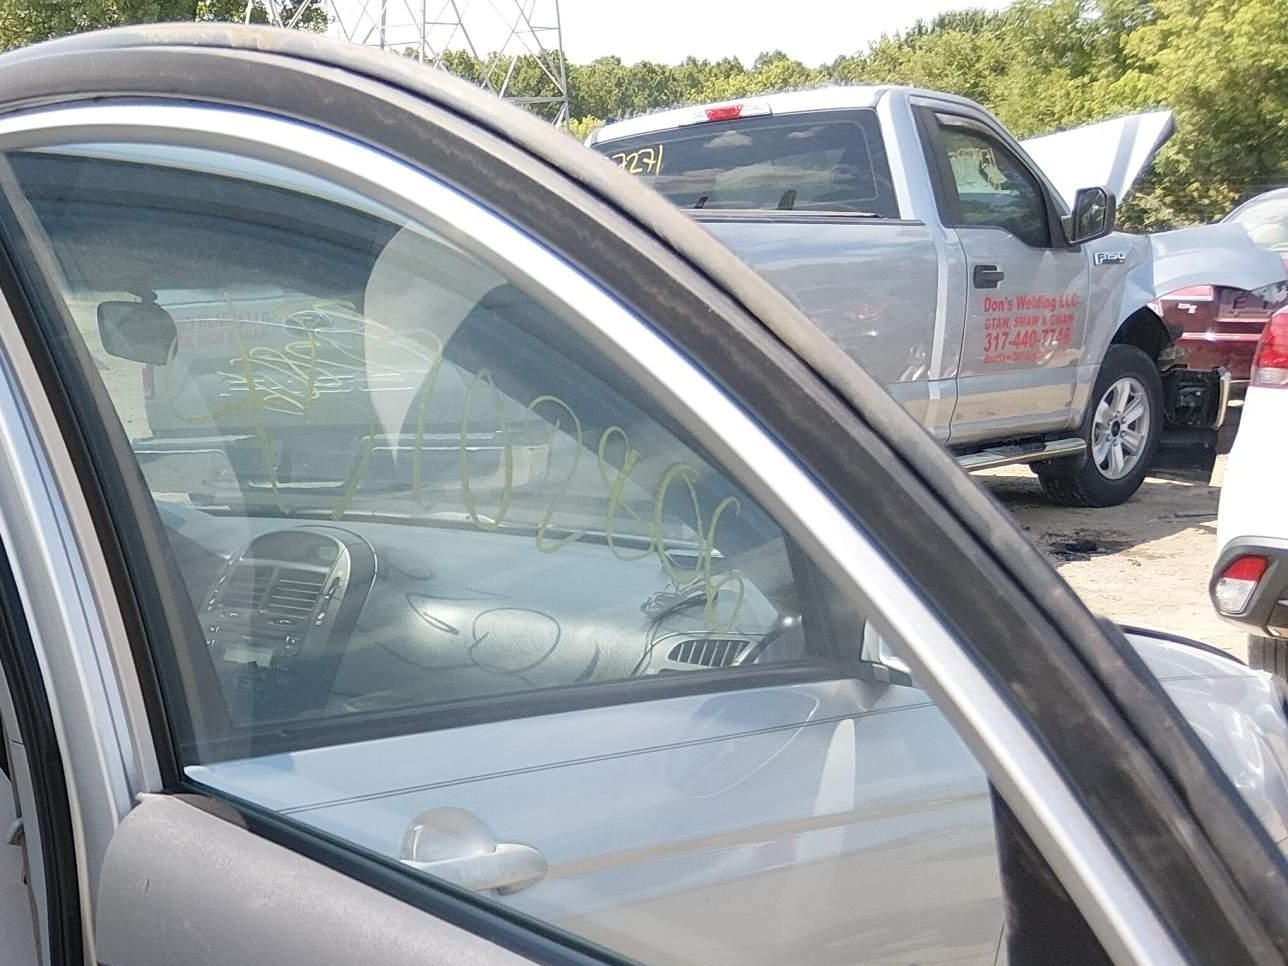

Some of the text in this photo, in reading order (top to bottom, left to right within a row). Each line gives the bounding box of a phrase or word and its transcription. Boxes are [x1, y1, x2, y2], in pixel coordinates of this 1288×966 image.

[984, 293, 1078, 312] Don's Welding LLC
[984, 317, 1011, 330] GTAW,
[1014, 315, 1040, 327] SMAW
[1049, 312, 1075, 325] GMAW
